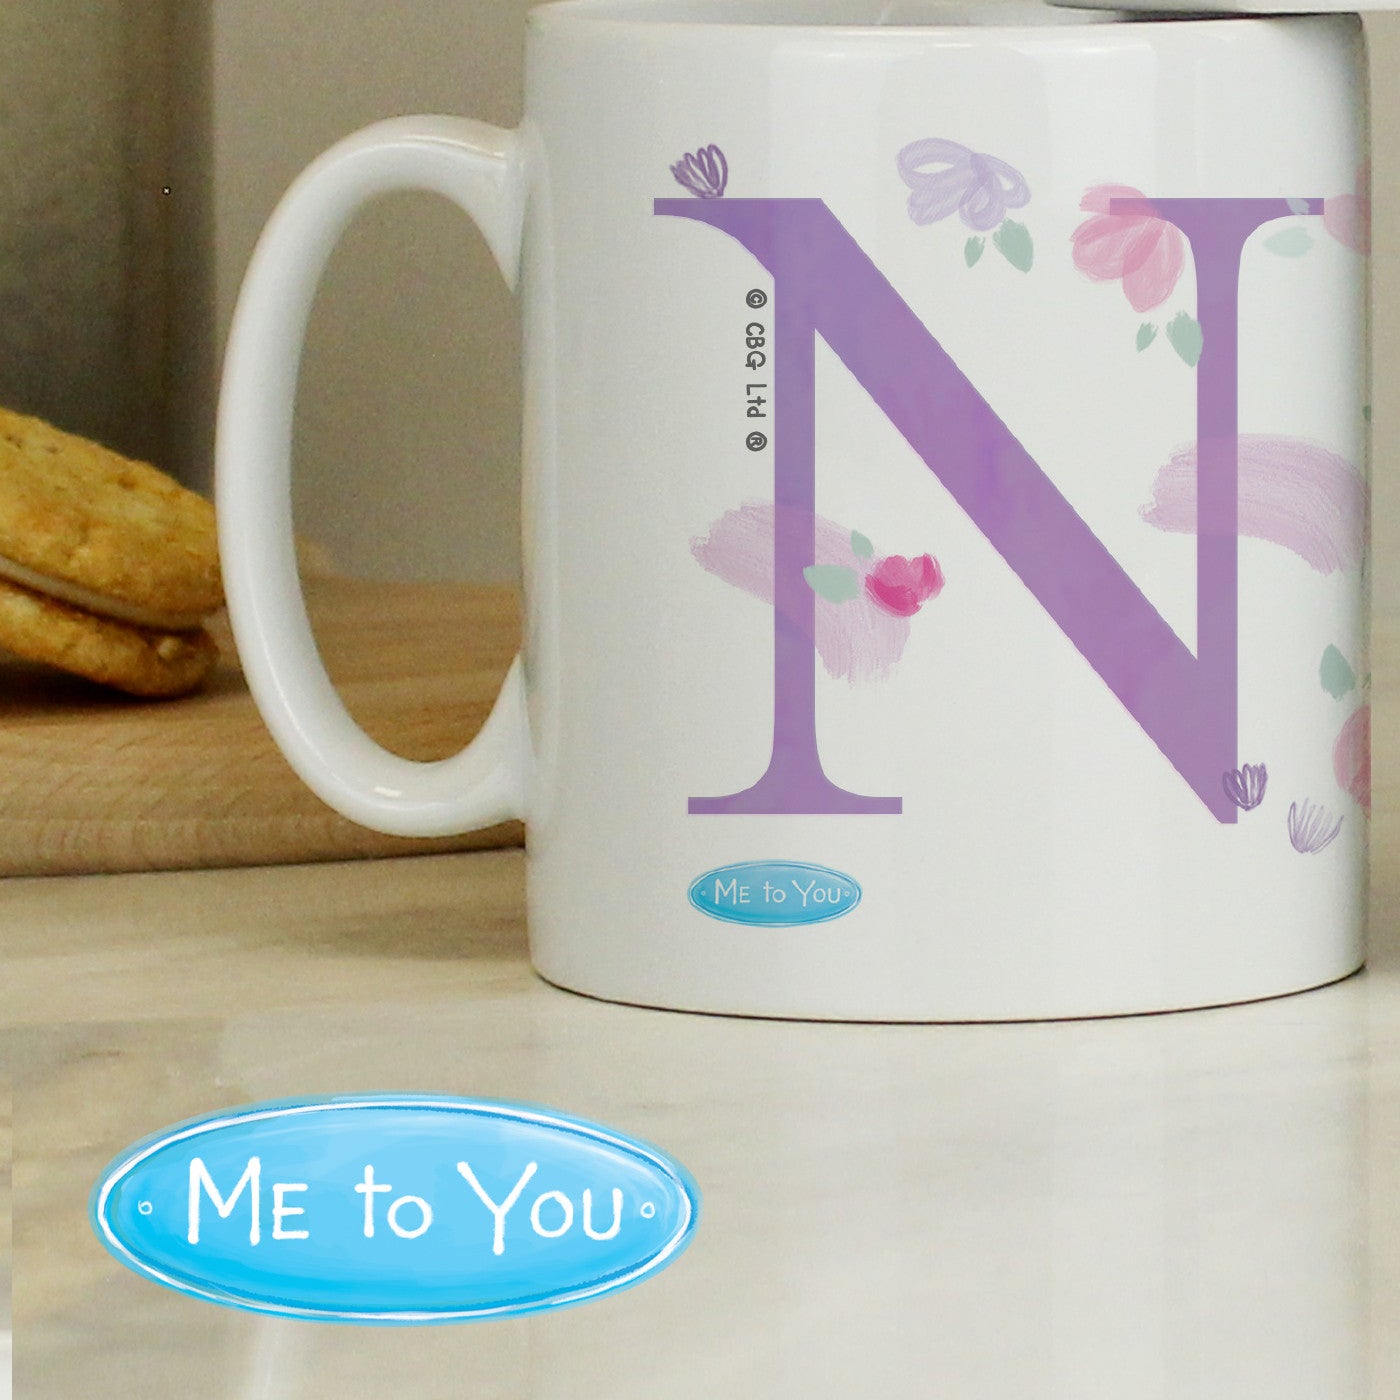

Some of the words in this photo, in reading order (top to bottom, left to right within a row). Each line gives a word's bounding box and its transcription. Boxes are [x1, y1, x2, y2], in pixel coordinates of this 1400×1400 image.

[745, 322, 767, 370] CBG
[745, 383, 768, 418] Ltd
[653, 197, 1325, 825] N
[762, 881, 787, 903] to
